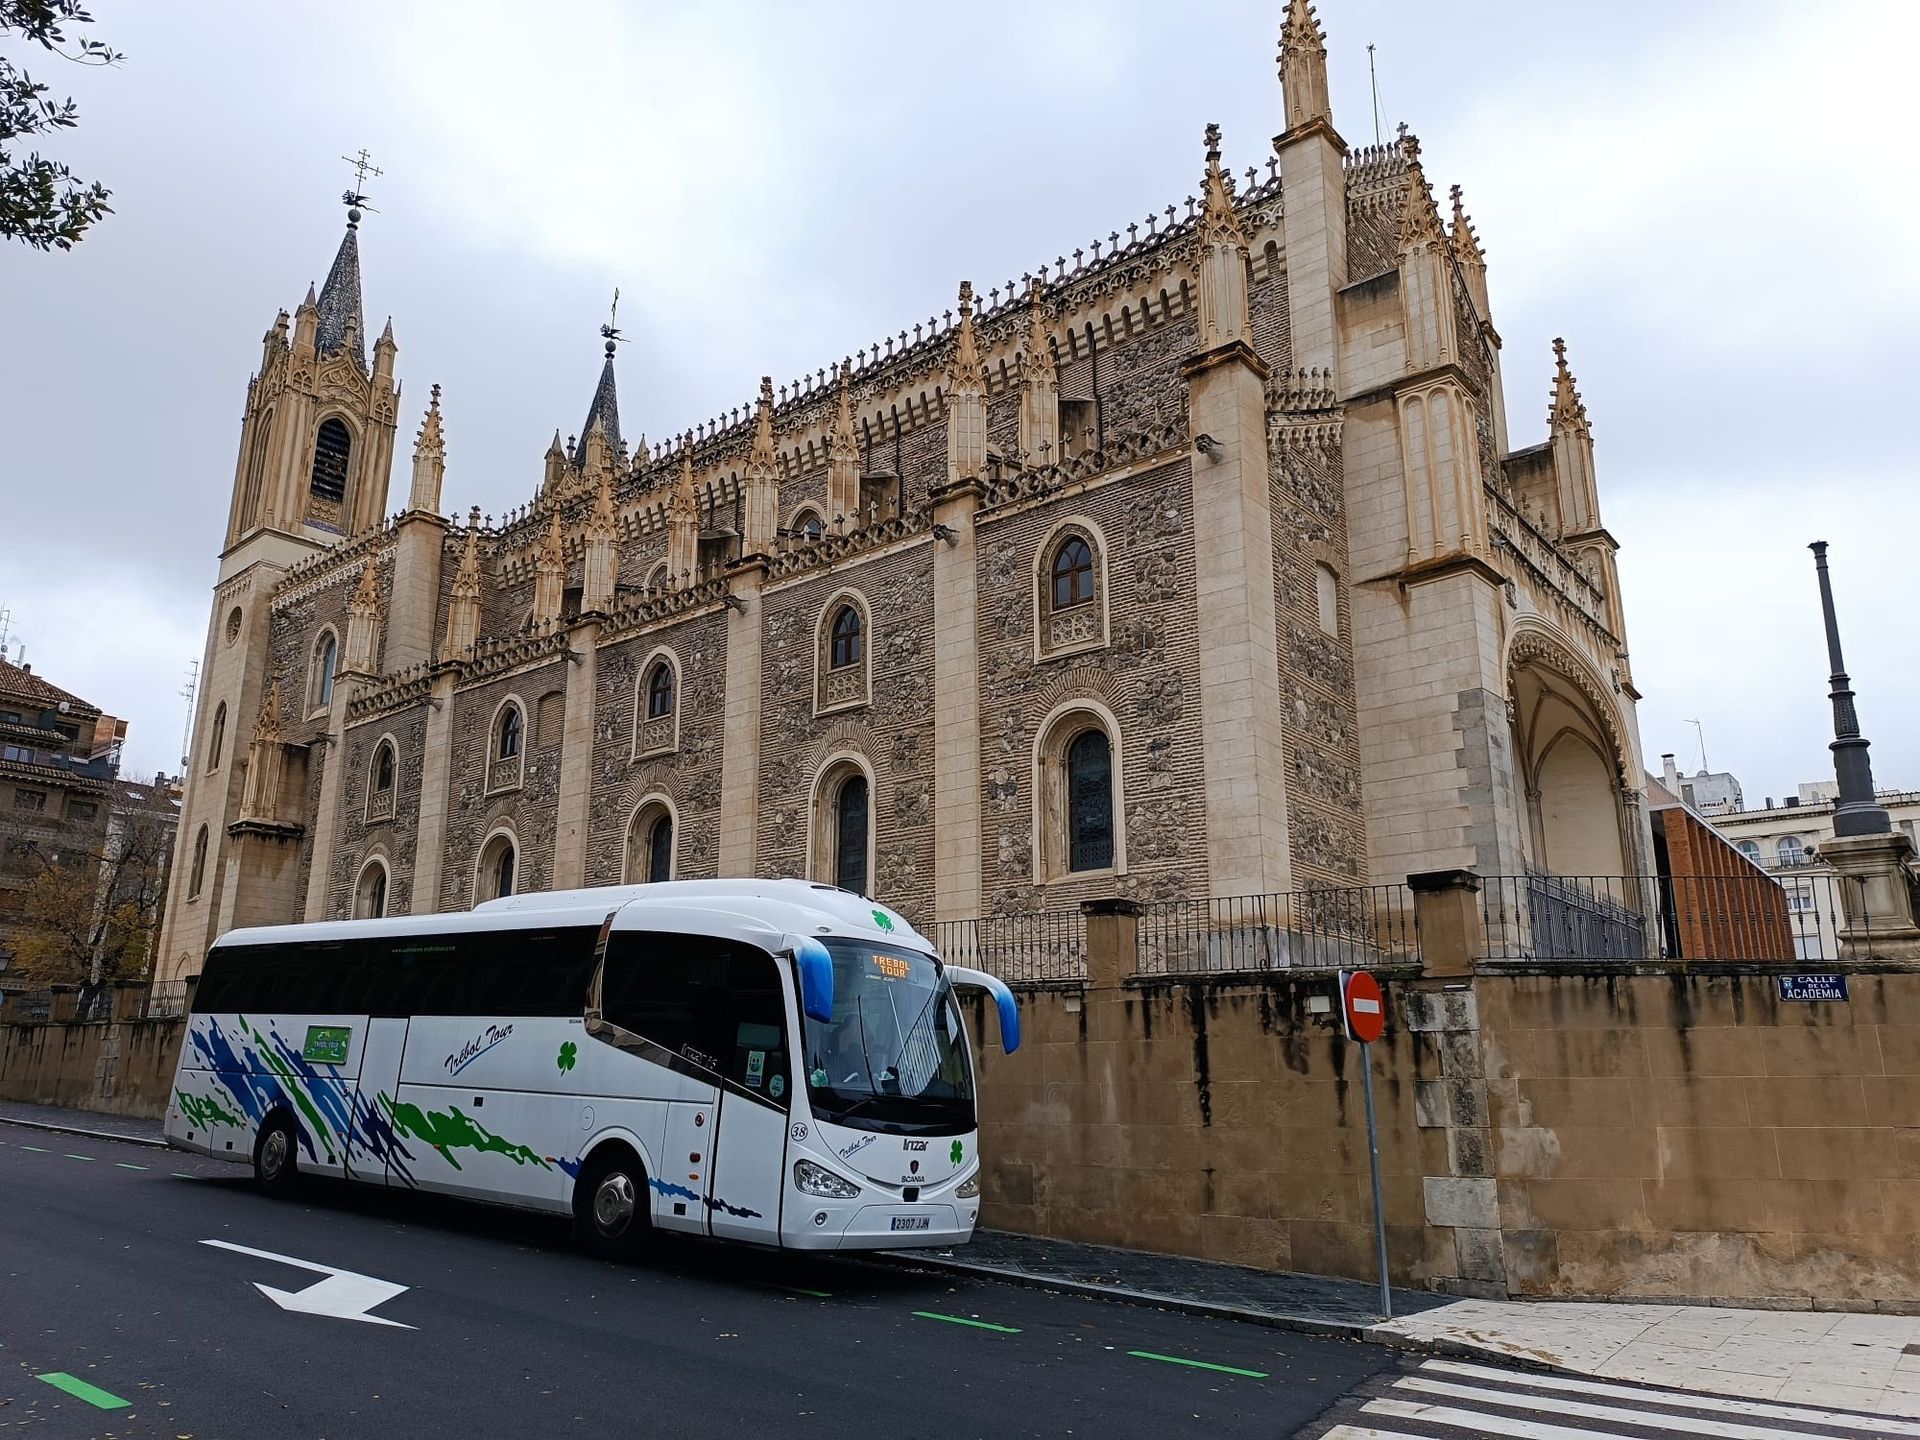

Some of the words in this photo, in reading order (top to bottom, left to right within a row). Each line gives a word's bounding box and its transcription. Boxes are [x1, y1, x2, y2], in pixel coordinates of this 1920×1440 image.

[872, 955, 911, 971] TREBOL
[880, 965, 906, 978] TOUR
[1797, 976, 1837, 984] CALLE
[1787, 988, 1842, 999] ACADEMIA
[485, 1024, 514, 1045] Tour
[793, 1126, 808, 1138] 38
[901, 1175, 926, 1183] SCANIA
[896, 1218, 915, 1229] 2307
